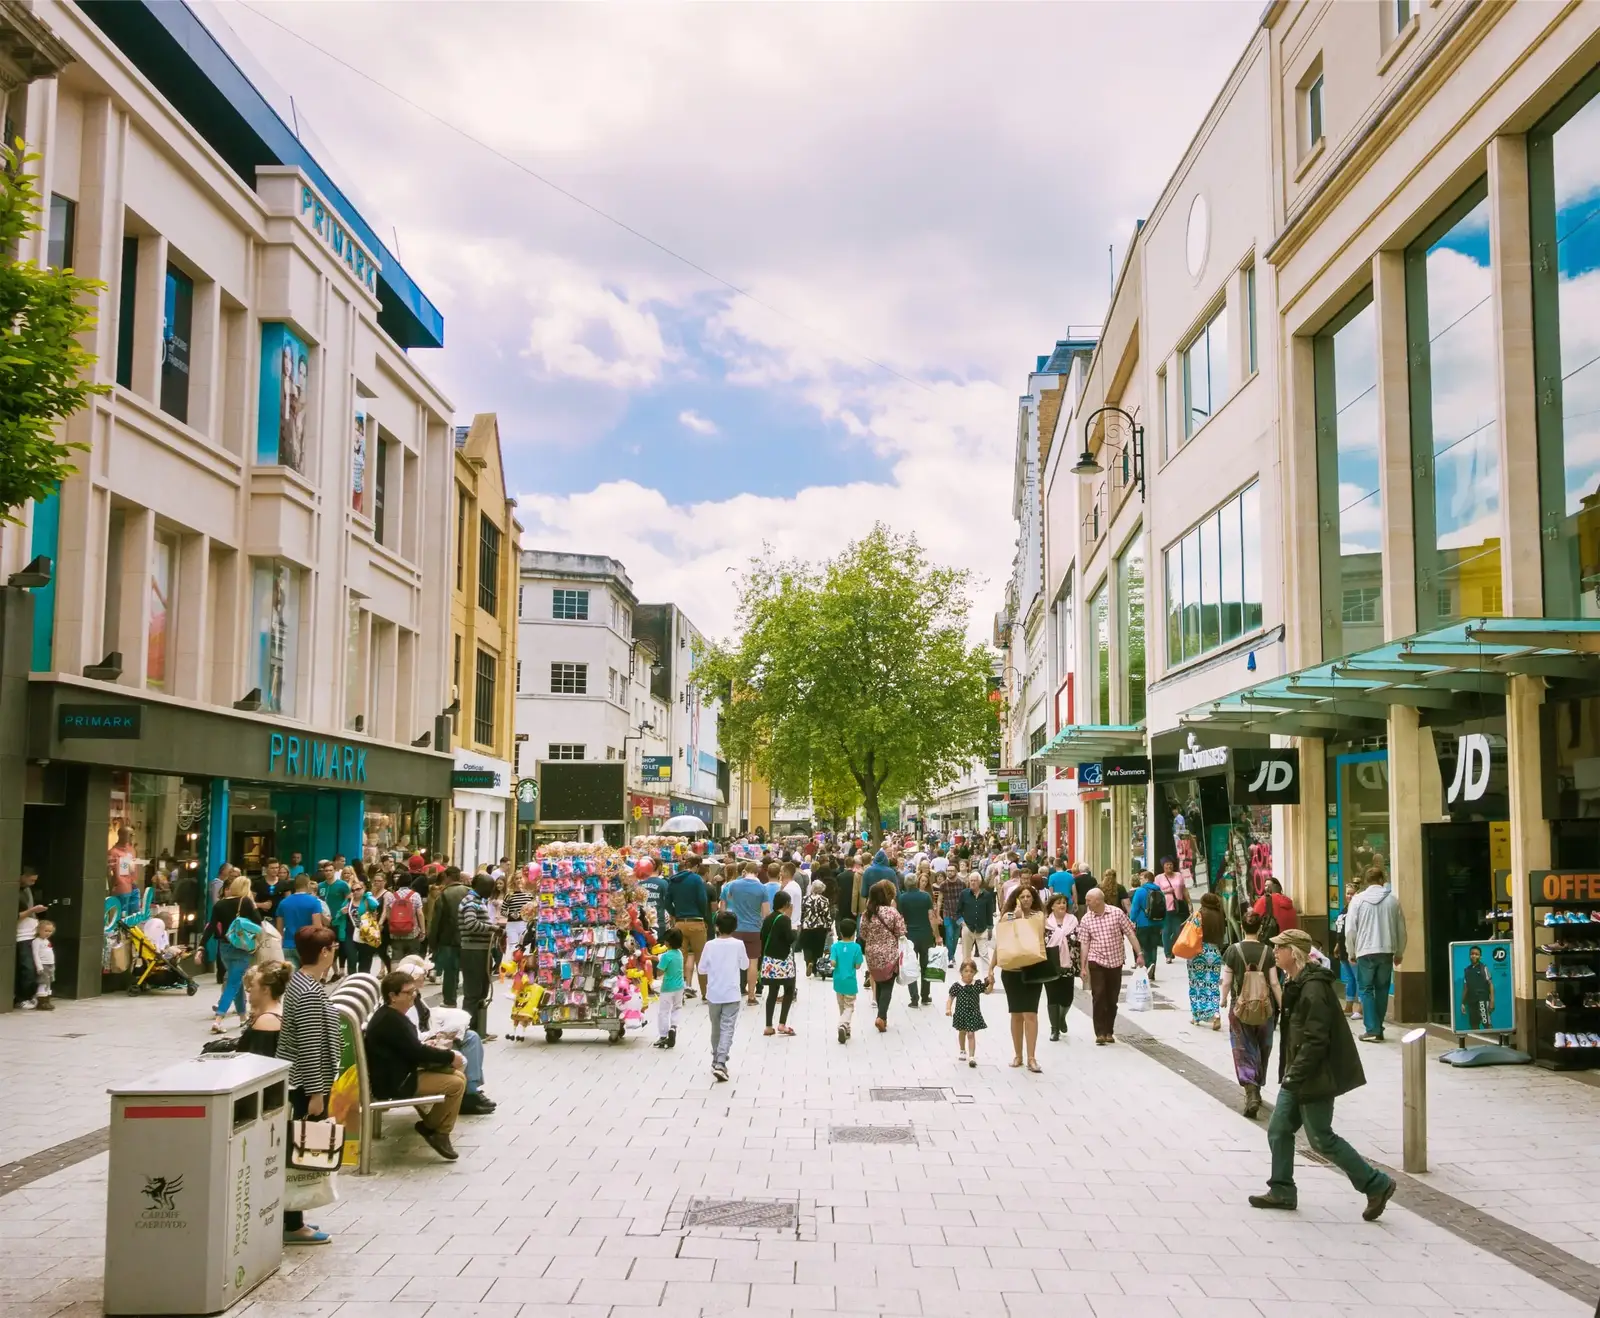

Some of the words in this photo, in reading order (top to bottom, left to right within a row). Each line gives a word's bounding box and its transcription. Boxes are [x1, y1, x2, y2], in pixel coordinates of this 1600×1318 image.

[300, 186, 374, 293] PRIMARK
[64, 716, 133, 727] PRIMARK
[269, 733, 368, 783] PRIMARK
[463, 763, 484, 771] Optical
[1119, 768, 1146, 776] Summers
[1448, 733, 1490, 804] JD
[1248, 760, 1294, 793] JD
[1494, 950, 1506, 959] JD
[286, 1173, 306, 1182] RIVER
[307, 1171, 331, 1181] ISLAND
[141, 1210, 180, 1219] CARDIFF
[135, 1220, 187, 1229] CAERDYDD
